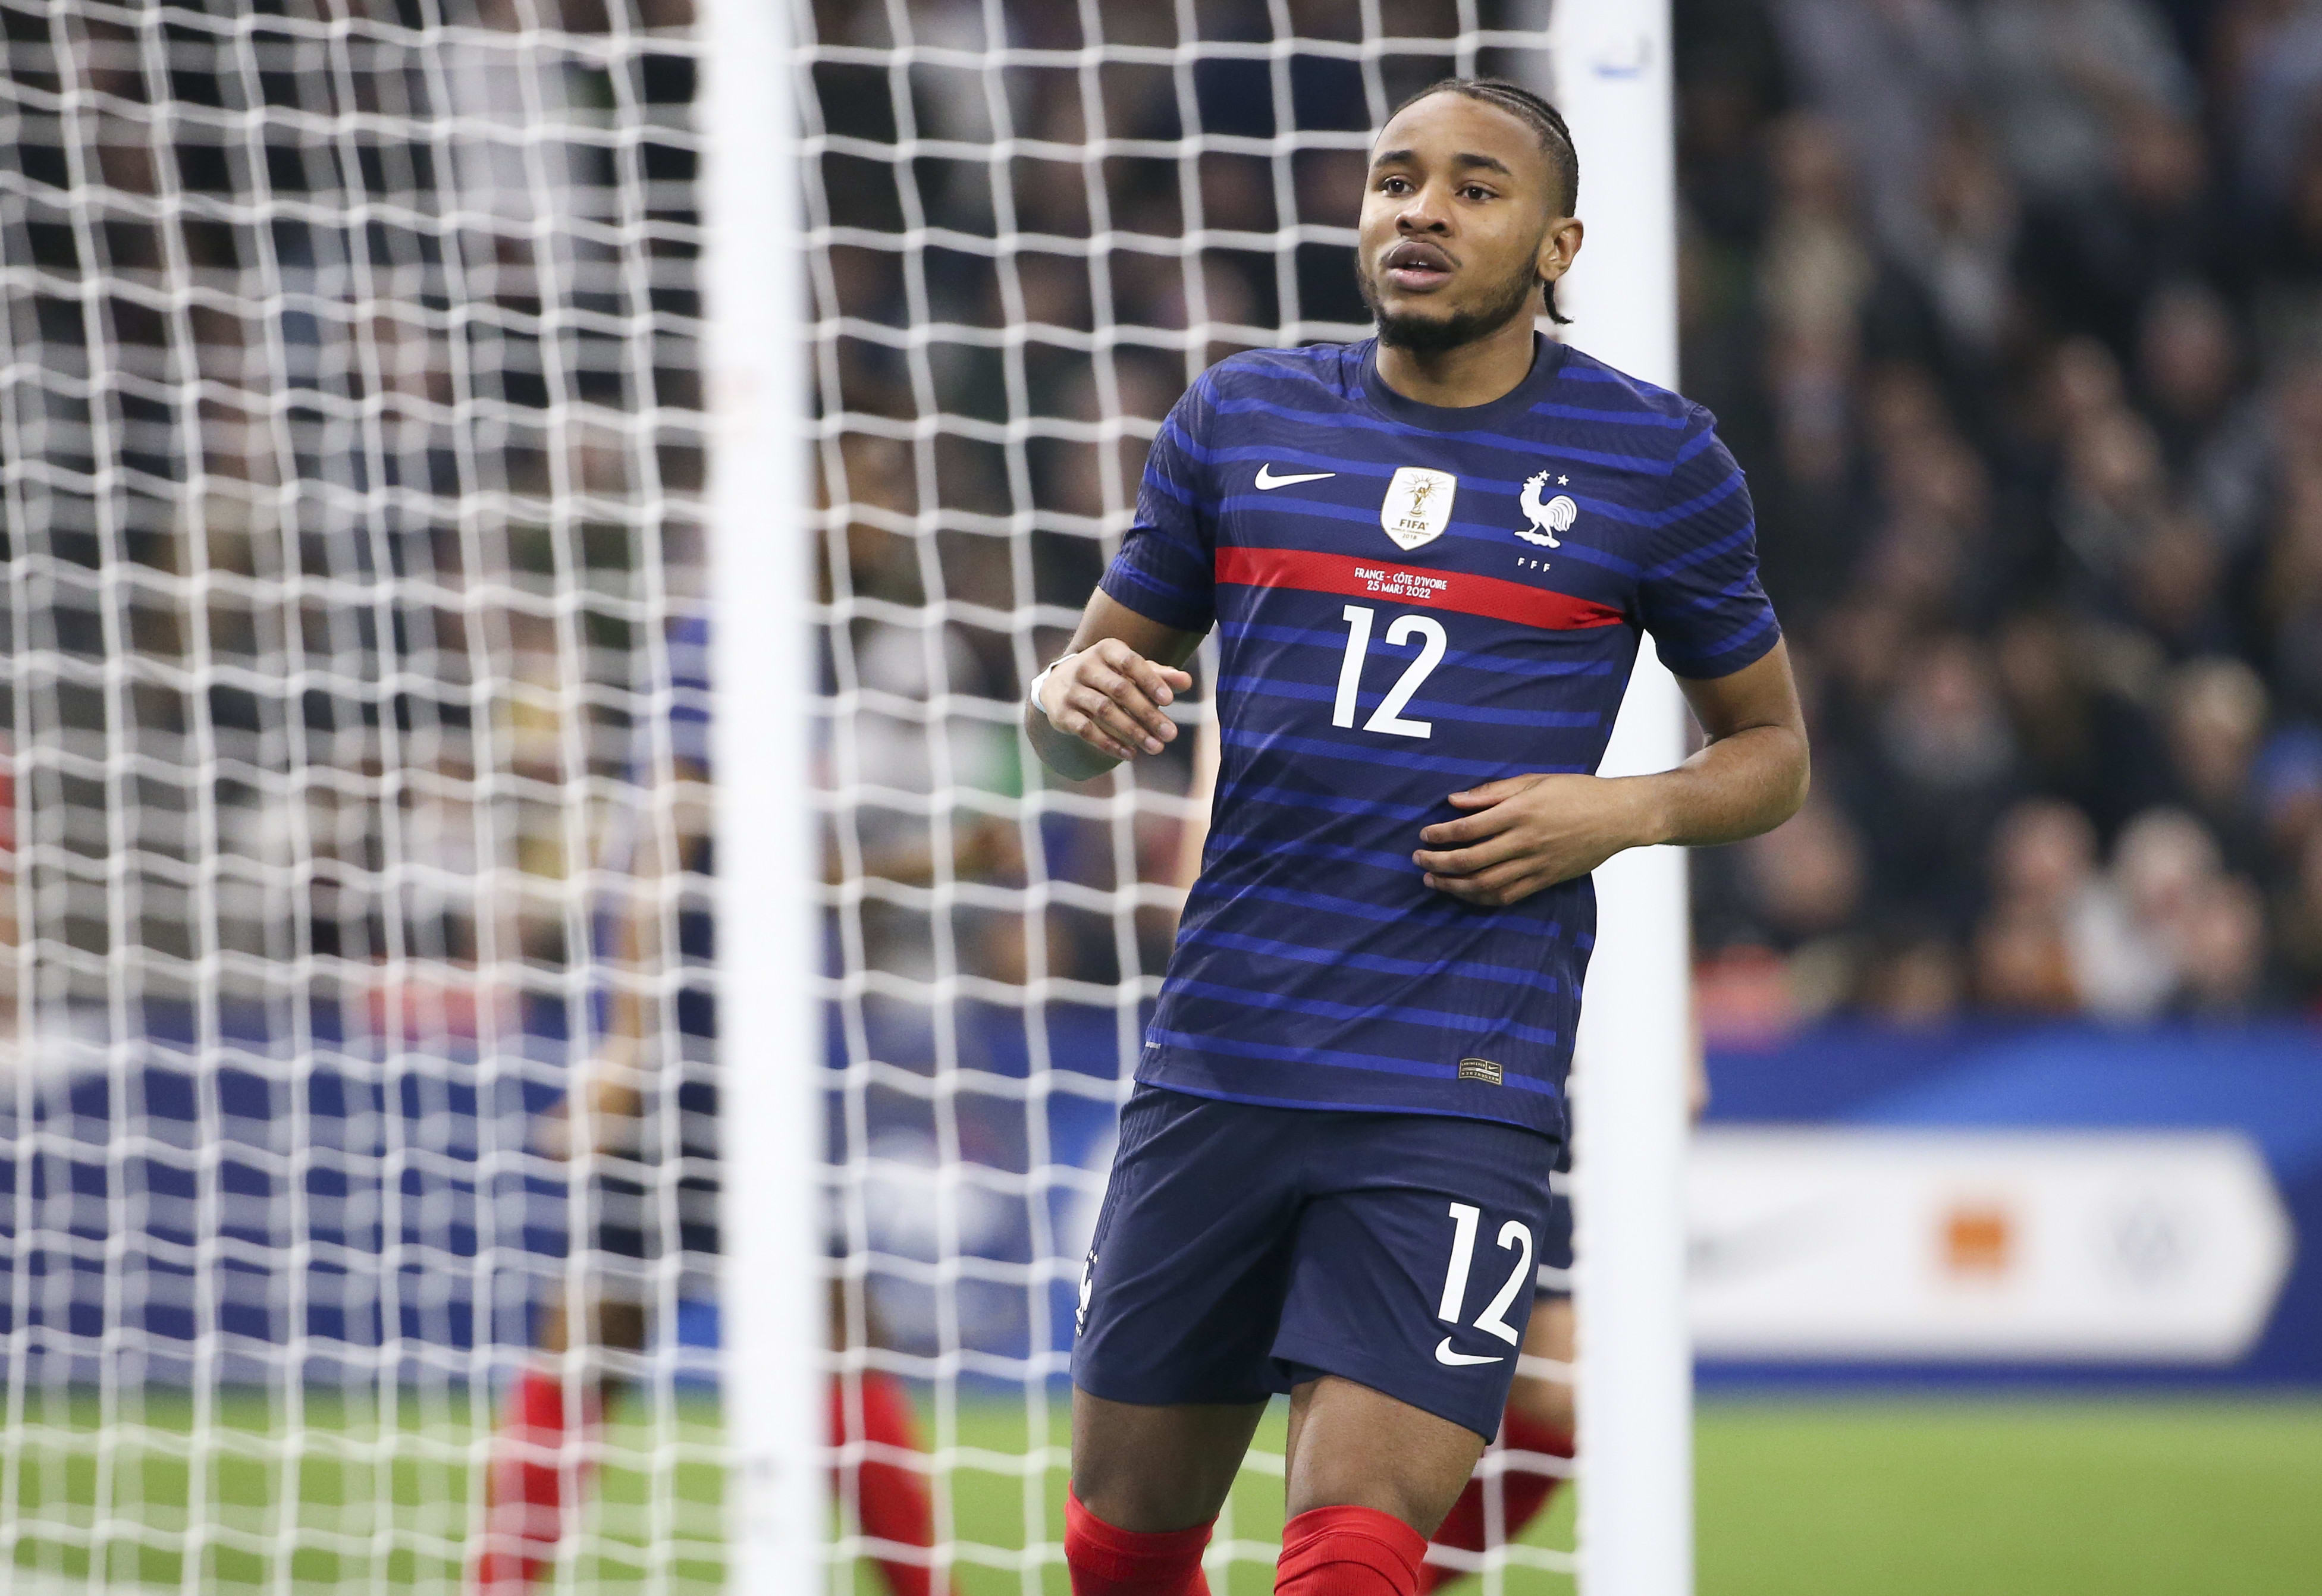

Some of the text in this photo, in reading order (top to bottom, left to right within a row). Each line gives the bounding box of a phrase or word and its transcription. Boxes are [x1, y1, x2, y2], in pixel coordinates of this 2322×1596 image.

[1400, 519, 1426, 530] FIFA
[1354, 567, 1385, 582] FRANCE
[1392, 571, 1414, 585] CÔTE
[1414, 575, 1448, 590] D'IVOIRE
[1366, 579, 1431, 599] 25 MARS 2022
[1332, 604, 1448, 739] 12
[1438, 1201, 1533, 1347] 12
